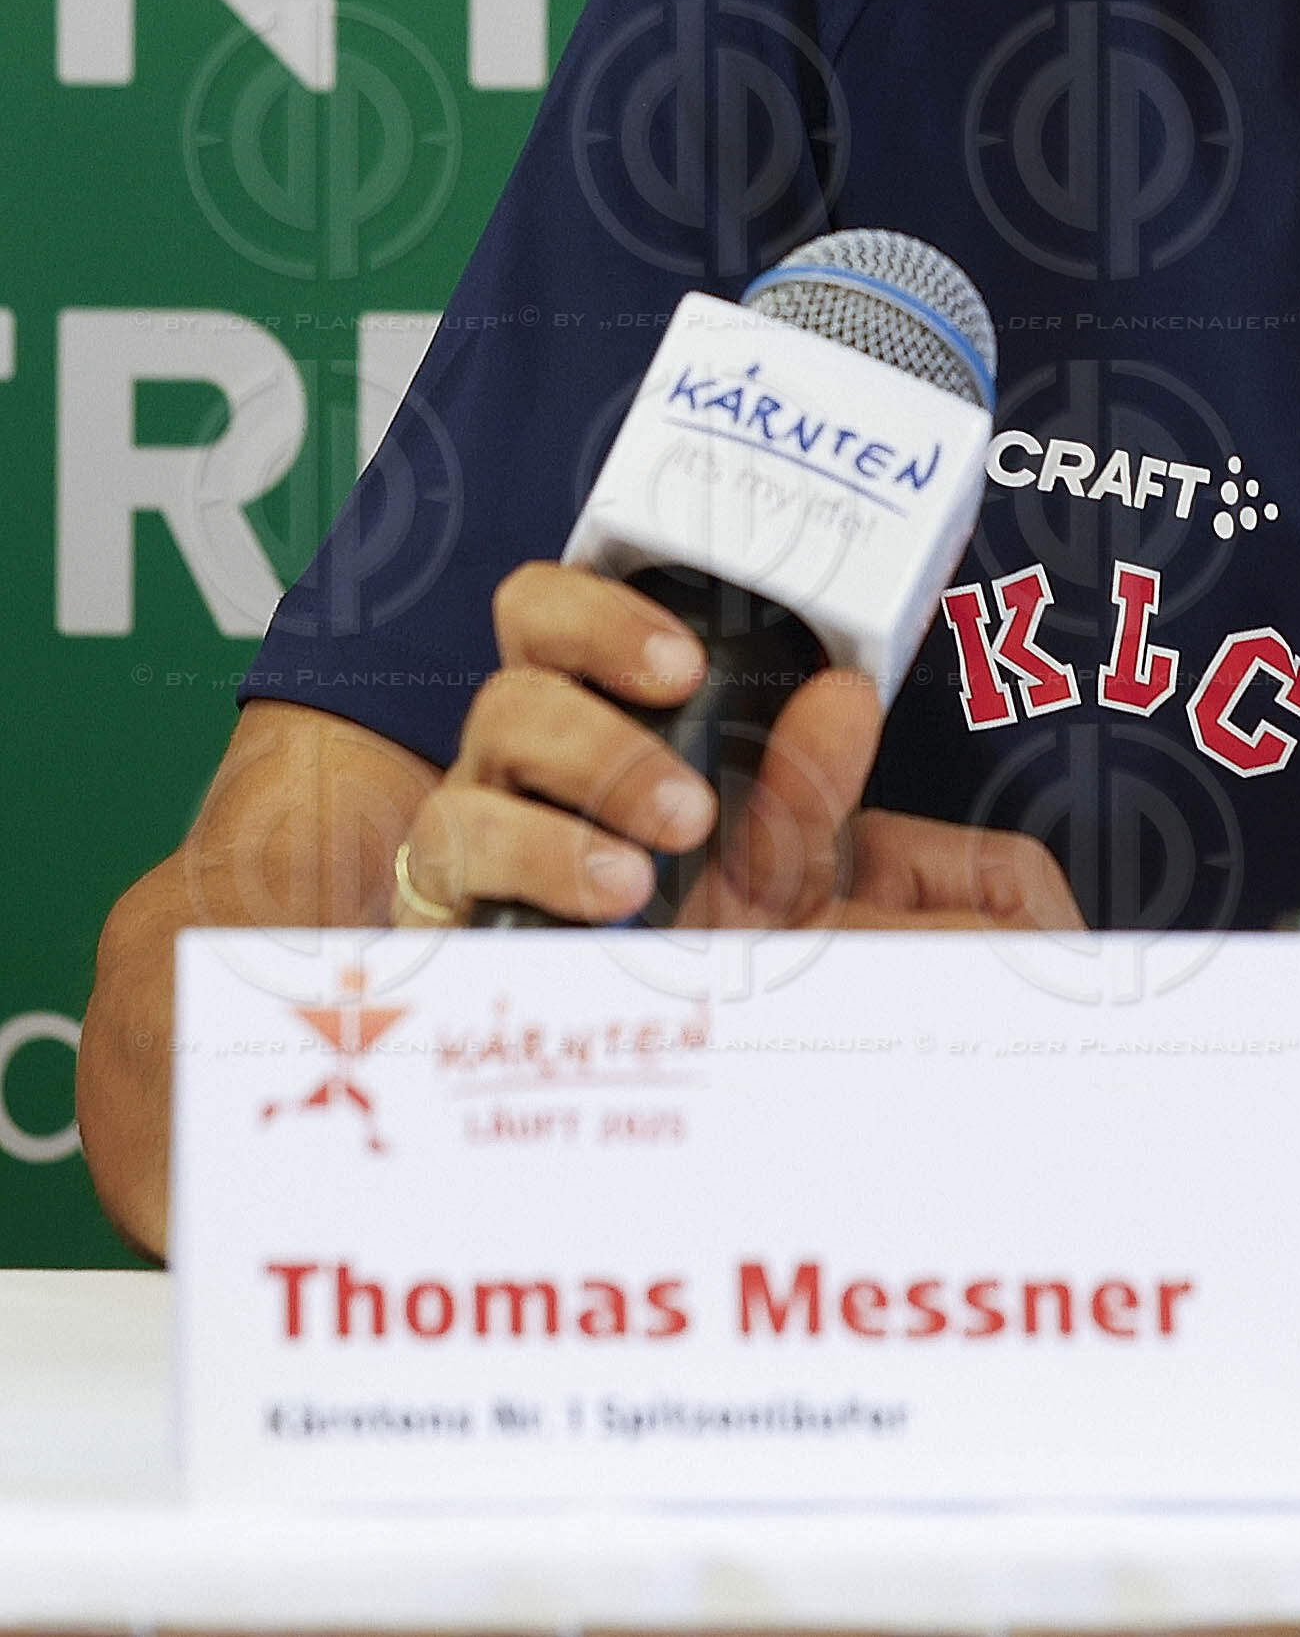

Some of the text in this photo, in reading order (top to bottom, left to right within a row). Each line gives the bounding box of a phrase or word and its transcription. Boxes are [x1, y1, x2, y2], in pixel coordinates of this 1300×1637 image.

[984, 429, 1211, 520] CRAFT
[266, 1260, 1196, 1340] Thomas Messner
